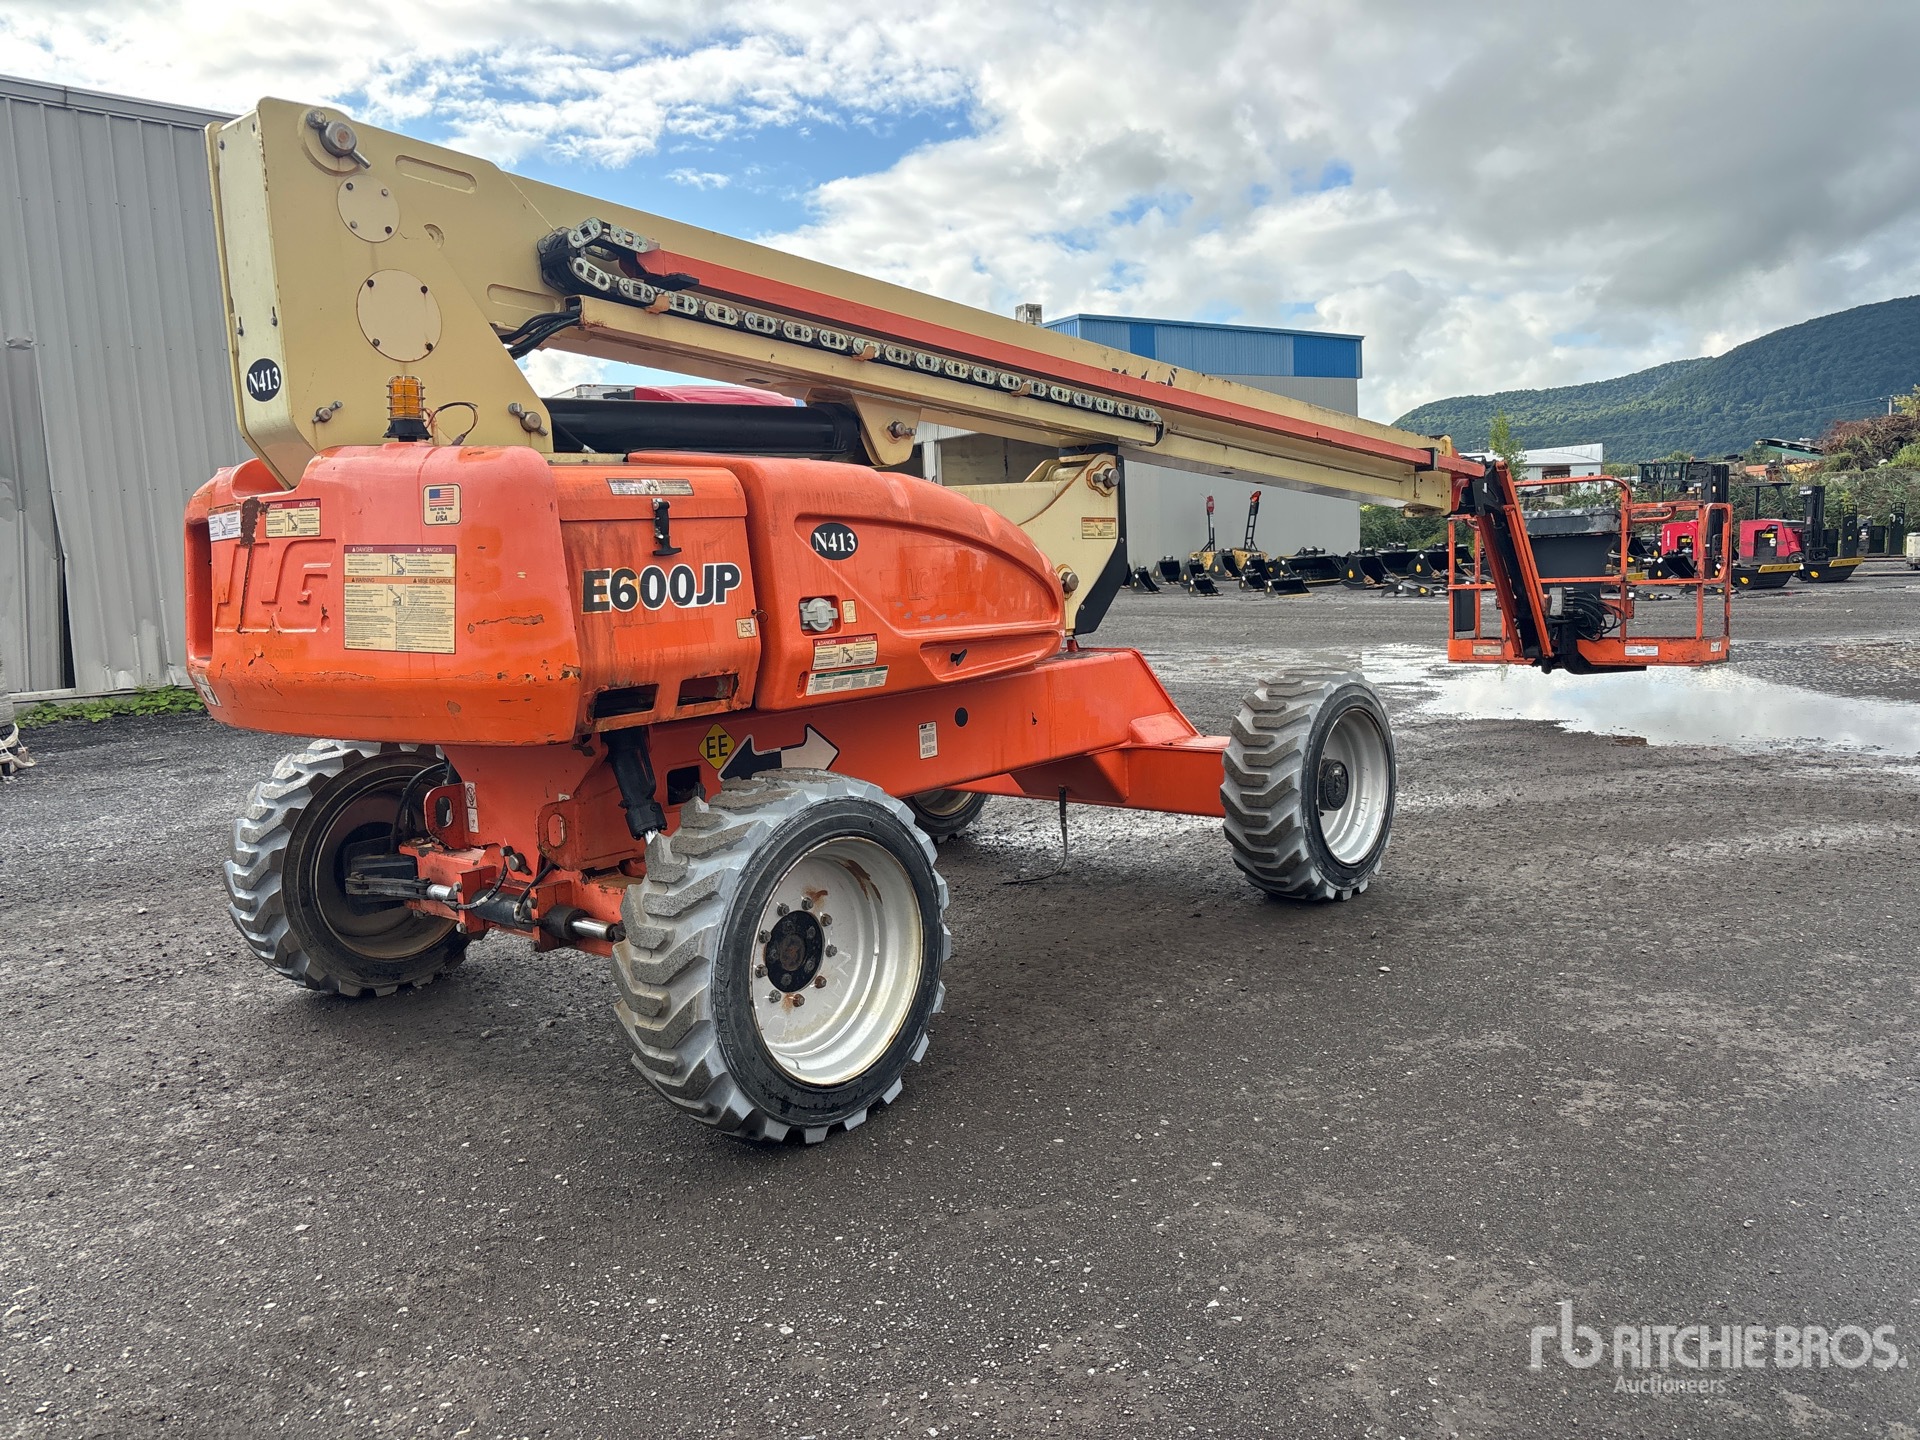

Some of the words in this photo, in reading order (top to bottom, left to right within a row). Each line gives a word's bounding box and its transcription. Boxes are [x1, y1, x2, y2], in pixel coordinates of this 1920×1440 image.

[248, 367, 280, 394] N413
[813, 532, 856, 552] N413
[582, 563, 741, 613] E600JP
[706, 734, 728, 759] EE
